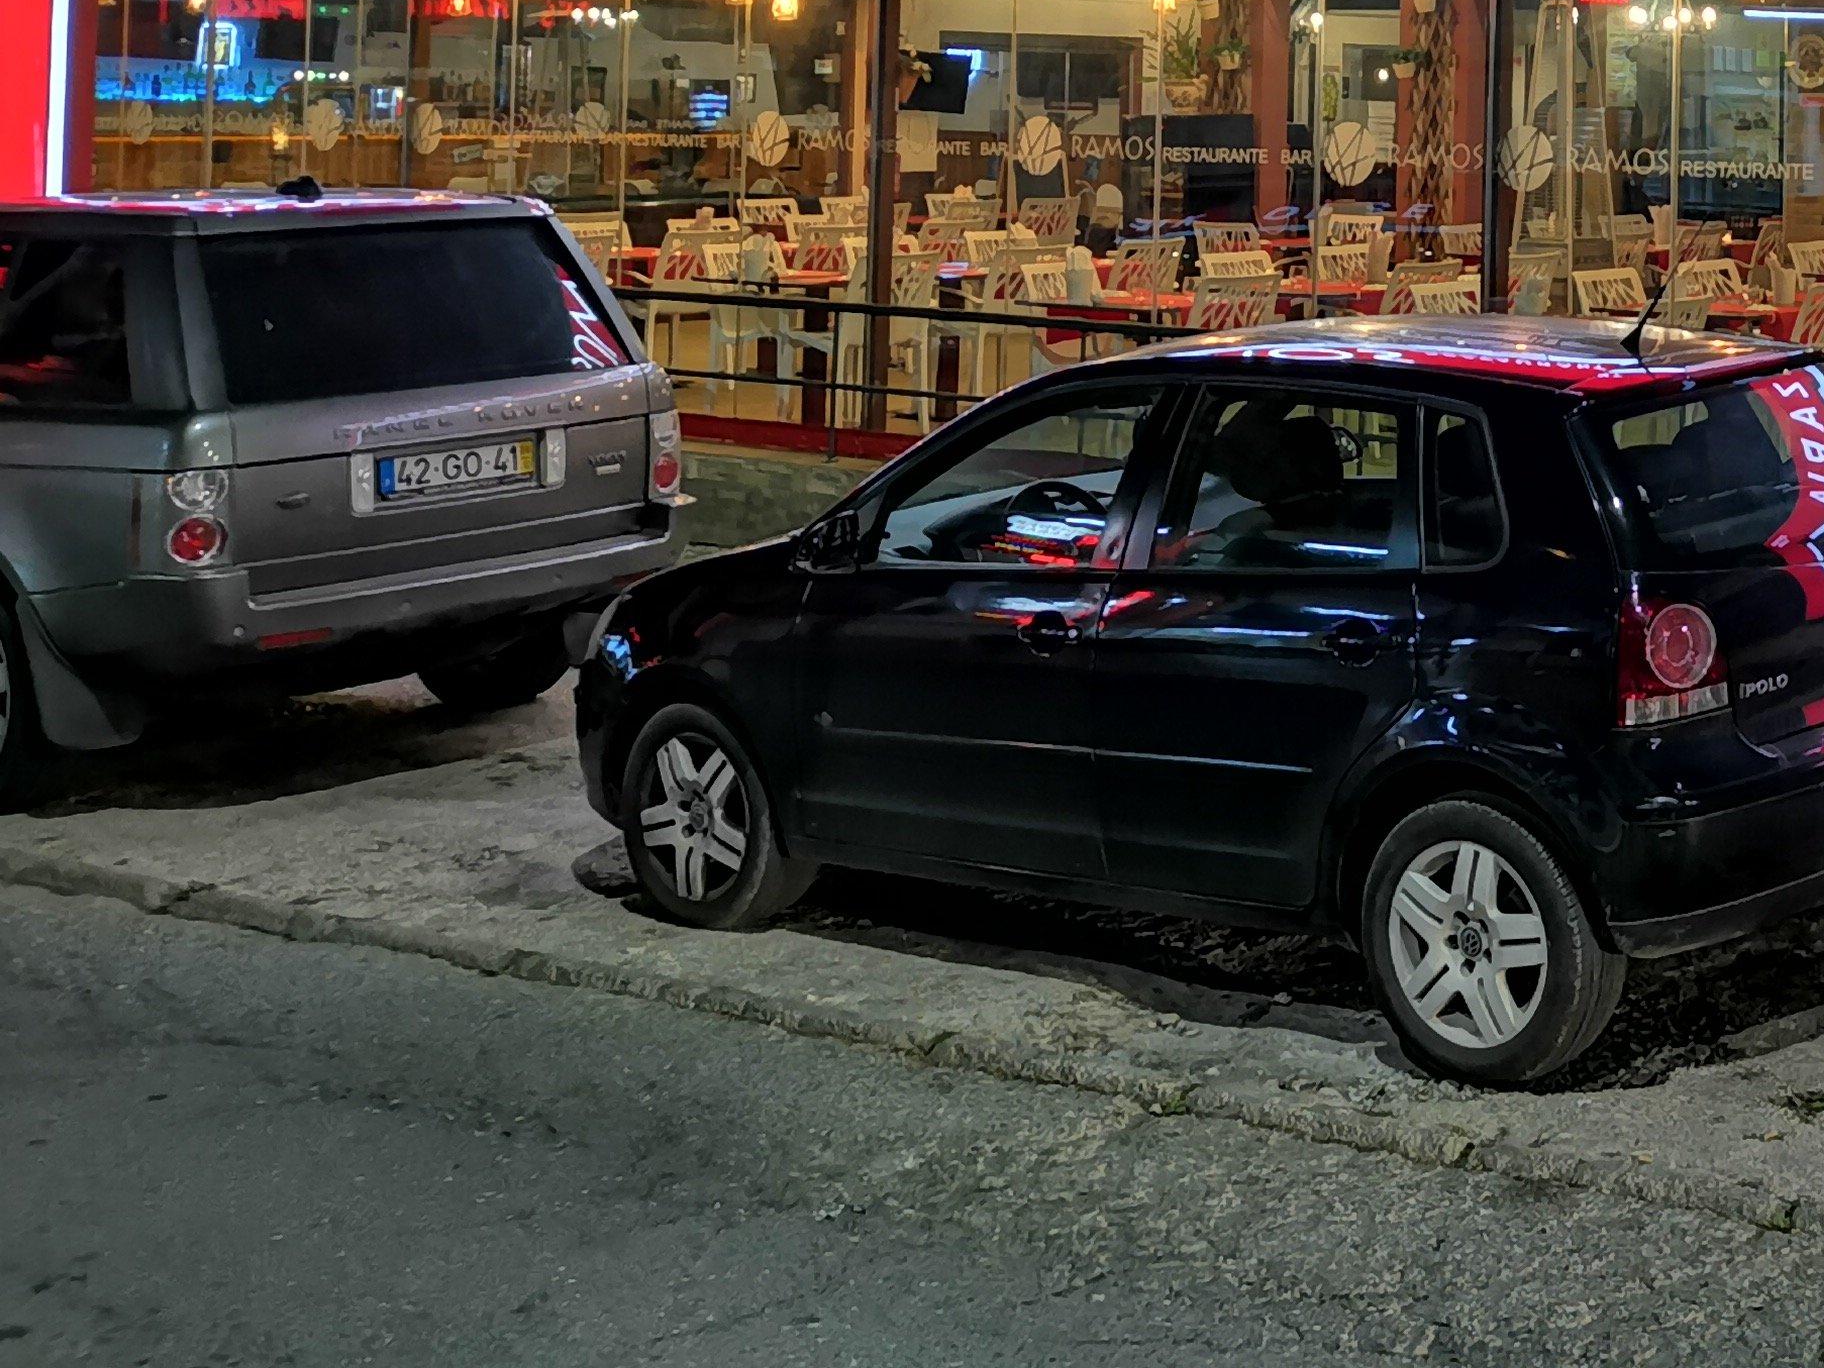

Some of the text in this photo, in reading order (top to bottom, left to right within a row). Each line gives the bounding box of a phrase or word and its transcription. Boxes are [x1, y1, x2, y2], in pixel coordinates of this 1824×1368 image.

[1071, 134, 1313, 167] RAMOS RESTAURANTE BAR
[1387, 143, 1484, 172] RAMOS
[1566, 147, 1671, 177] RAMOS
[1680, 160, 1815, 181] RESTAURANTE
